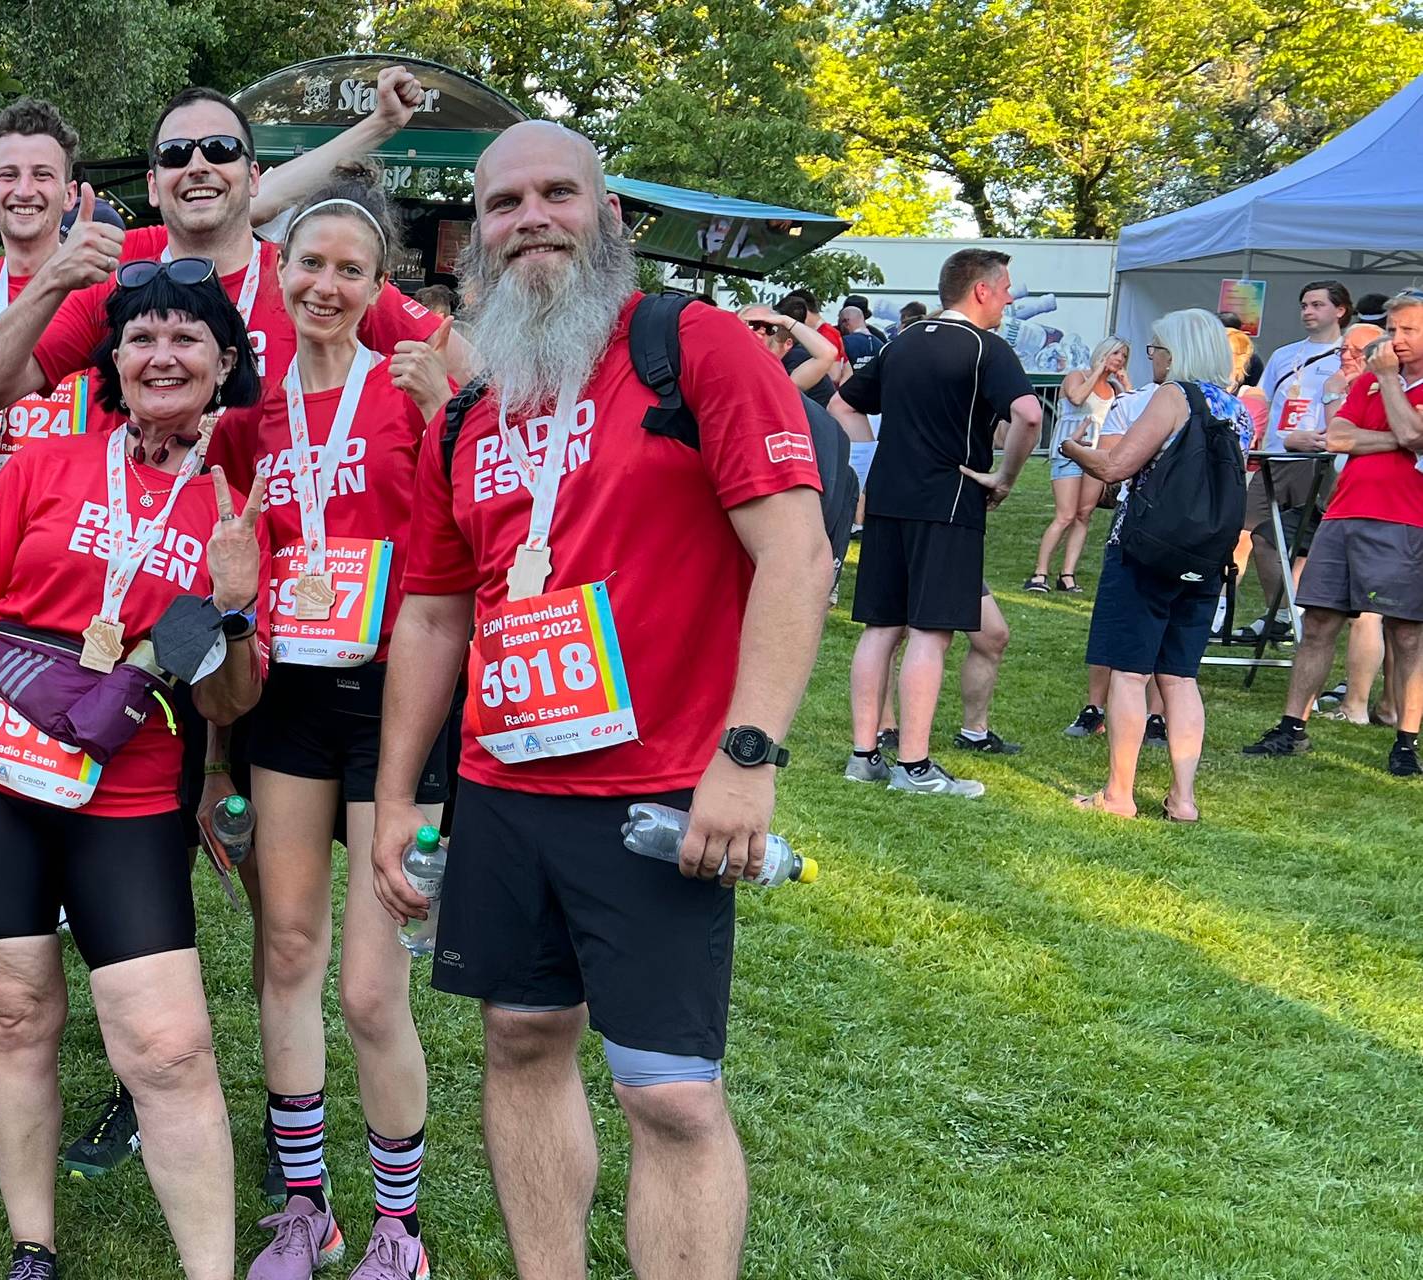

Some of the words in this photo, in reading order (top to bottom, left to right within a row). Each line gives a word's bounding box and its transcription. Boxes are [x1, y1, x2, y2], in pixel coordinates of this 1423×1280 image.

[476, 399, 596, 471] RADO
[329, 561, 364, 575] 2022
[269, 578, 363, 619] 597
[301, 624, 336, 636] Essen
[483, 618, 503, 638] E.ON
[504, 600, 579, 630] Firmenlauf
[502, 629, 539, 648] Essen
[542, 618, 583, 639] 2022
[481, 642, 597, 708] 5918
[504, 712, 536, 727] Radio
[538, 704, 579, 720] Essen
[545, 731, 579, 743] CUBION
[23, 750, 57, 768] Essen
